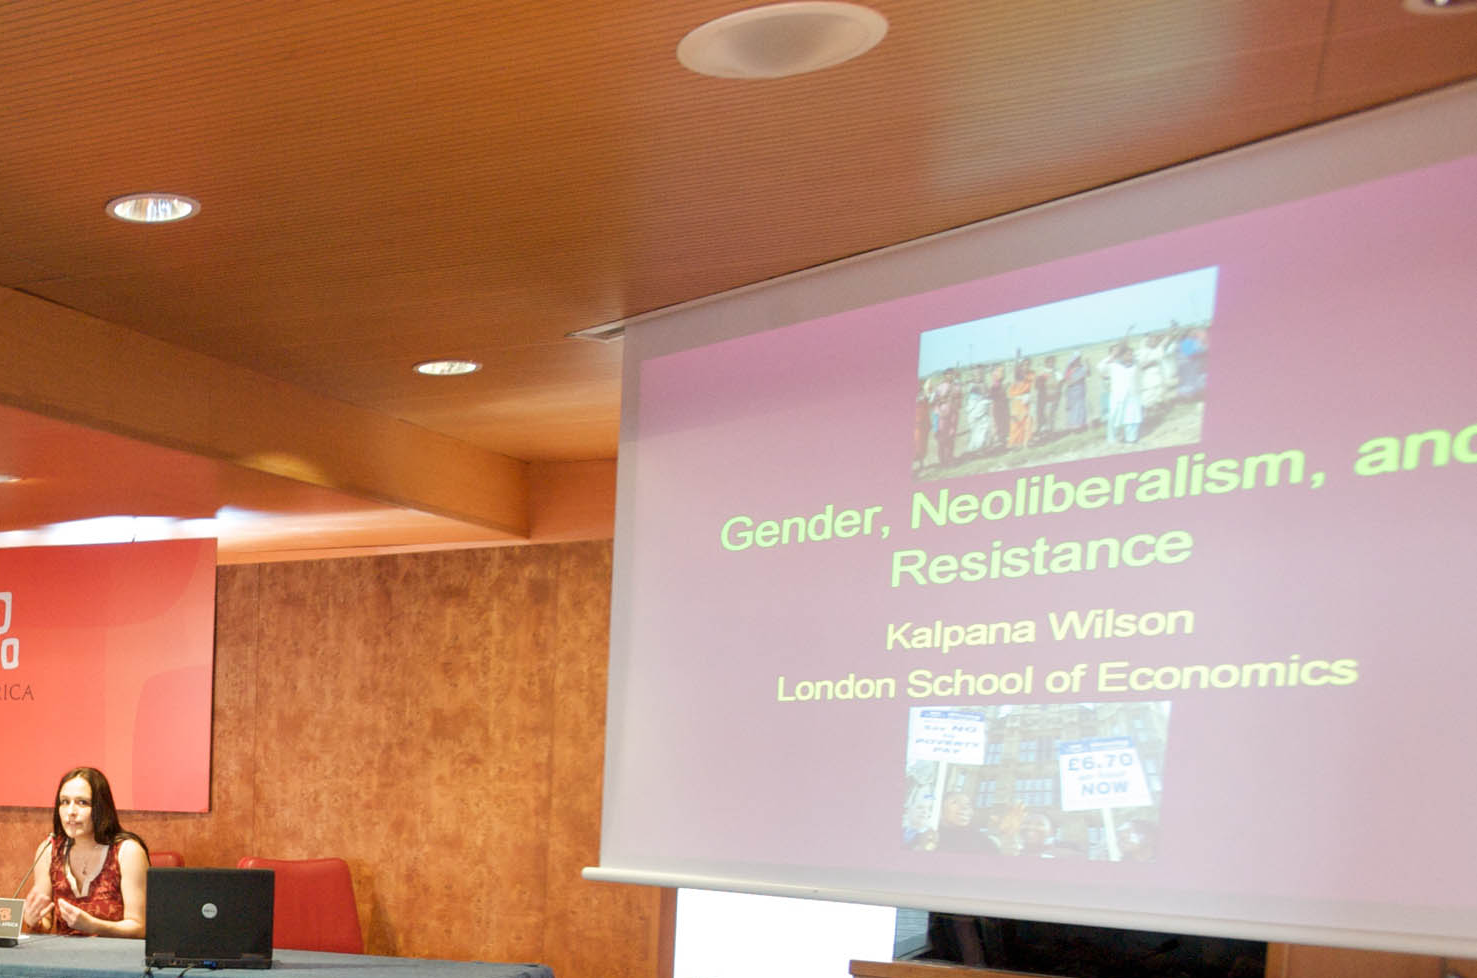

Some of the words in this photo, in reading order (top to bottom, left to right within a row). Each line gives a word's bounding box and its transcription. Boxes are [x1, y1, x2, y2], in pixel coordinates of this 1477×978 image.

[720, 503, 891, 551] Gender,
[910, 449, 1326, 529] Neoliberalism,
[890, 529, 1193, 588] Resistance
[886, 619, 1036, 653] Kalpana
[1048, 608, 1194, 641] Wilson
[777, 673, 896, 702] London
[907, 665, 1034, 698] School
[1045, 663, 1088, 694] of
[1097, 654, 1359, 693] Economics
[1082, 780, 1128, 796] NOW
